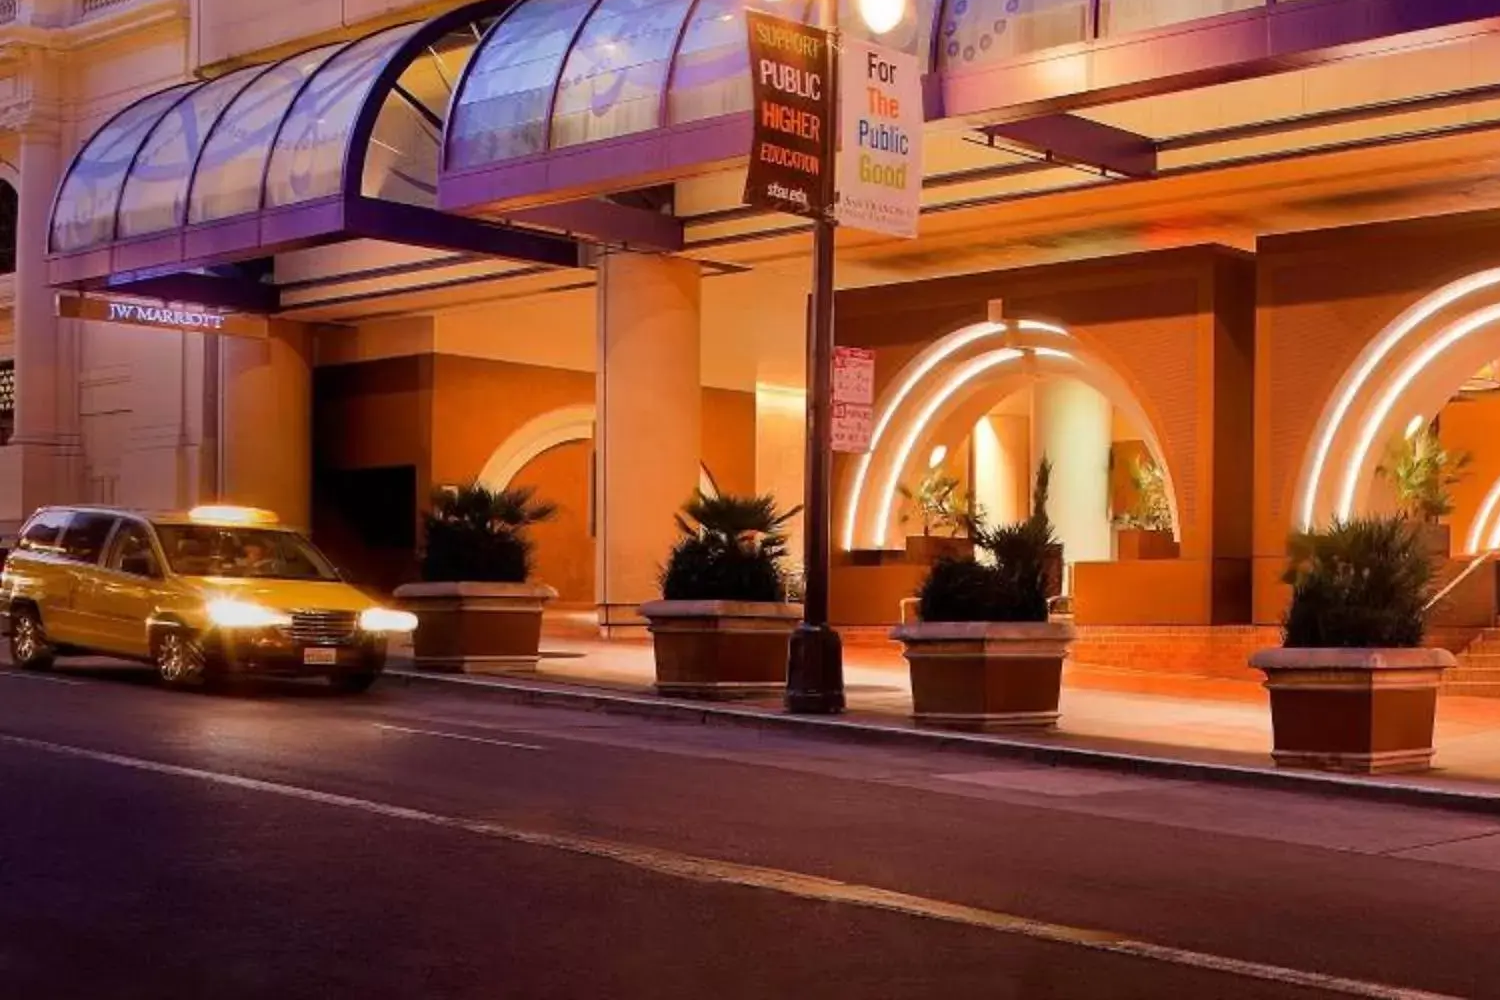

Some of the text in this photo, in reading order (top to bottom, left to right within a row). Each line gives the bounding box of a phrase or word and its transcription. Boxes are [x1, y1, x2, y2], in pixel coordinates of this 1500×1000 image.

[756, 22, 819, 58] SUPPORT
[760, 59, 821, 101] PUBLIC
[868, 51, 897, 84] For
[867, 87, 899, 119] The
[762, 101, 820, 143] HIGHER
[859, 120, 909, 155] Public
[760, 142, 819, 176] EDUCATION
[860, 154, 907, 190] Good
[109, 303, 225, 329] JW MARRIOTT
